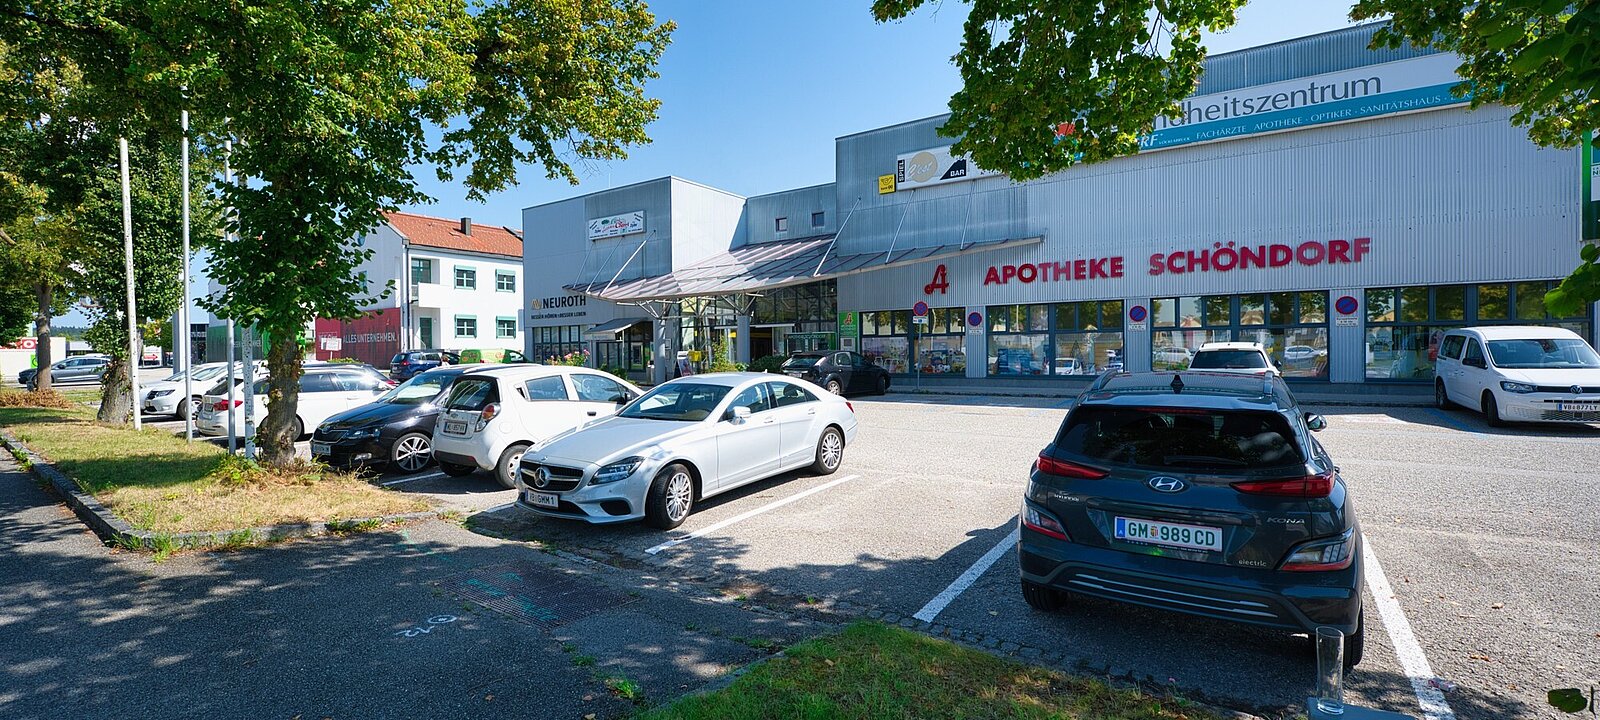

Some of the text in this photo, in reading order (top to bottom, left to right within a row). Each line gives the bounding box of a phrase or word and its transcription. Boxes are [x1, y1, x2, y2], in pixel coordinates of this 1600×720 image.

[1153, 76, 1381, 130] ndheitszentrum
[1196, 126, 1247, 140] FACHÄRZTE
[1253, 116, 1303, 131] APOTHEKE
[1310, 108, 1352, 122] OPTIKER
[1360, 94, 1441, 115] SANITÄTSHAUS
[1140, 134, 1158, 148] RF
[950, 169, 965, 177] BAR
[984, 237, 1371, 286] APOTHEKE SCHÖNDORF
[542, 295, 587, 309] NEUROTH
[343, 333, 357, 343] ALLES
[1128, 522, 1215, 546] GM 989 CD
[1239, 559, 1267, 567] electric
